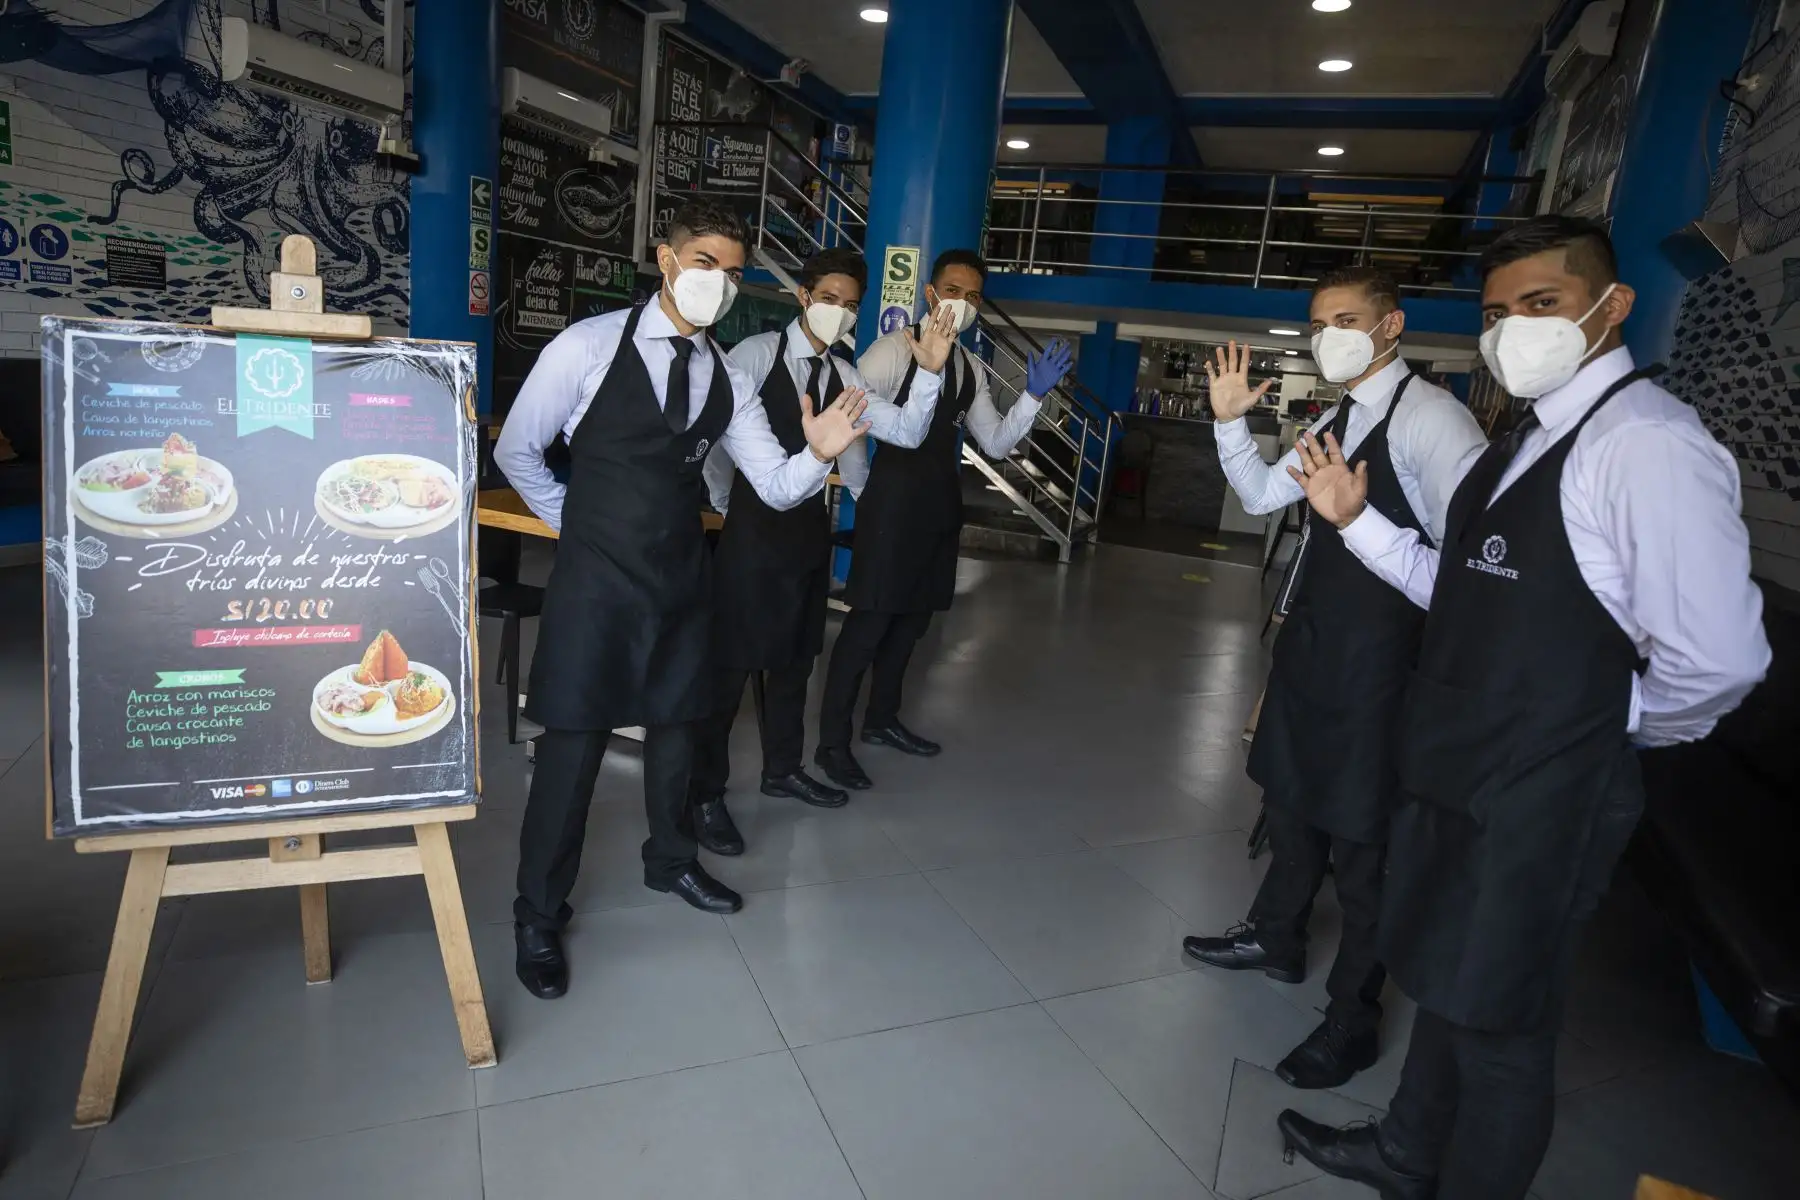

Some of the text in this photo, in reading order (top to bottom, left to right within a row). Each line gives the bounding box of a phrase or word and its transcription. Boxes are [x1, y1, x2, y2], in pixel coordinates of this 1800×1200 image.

[672, 84, 702, 113] EN EL
[513, 156, 548, 180] AMOR
[668, 159, 691, 182] BIEN
[512, 173, 535, 189] para
[107, 237, 165, 252] RECOMENDACIONES
[474, 229, 490, 253] S
[576, 253, 584, 267] EL
[889, 252, 912, 282] S
[525, 259, 564, 283] fallas
[525, 281, 560, 298] Cuando
[547, 298, 560, 311] de
[521, 312, 563, 327] INTENTARLO
[81, 395, 202, 413] Ceviche de pescado
[217, 398, 239, 413] EL
[241, 398, 331, 417] TRIDENTE
[81, 410, 214, 429] Causa de langostinos
[82, 425, 165, 438] Arroz norteño
[138, 541, 411, 577] Disfruta de nuestros
[1466, 557, 1520, 580] EL TRIDENTE
[184, 565, 382, 593] tríos divinos desde
[200, 628, 251, 647] Incluye
[296, 627, 311, 640] de
[313, 627, 352, 640] cortesía
[126, 687, 277, 705] Arroz con mariscos
[126, 700, 272, 719] Ceviche de pescado
[126, 715, 245, 733] Causa crocante
[126, 730, 237, 751] de langostinos
[210, 786, 244, 800] VISA
